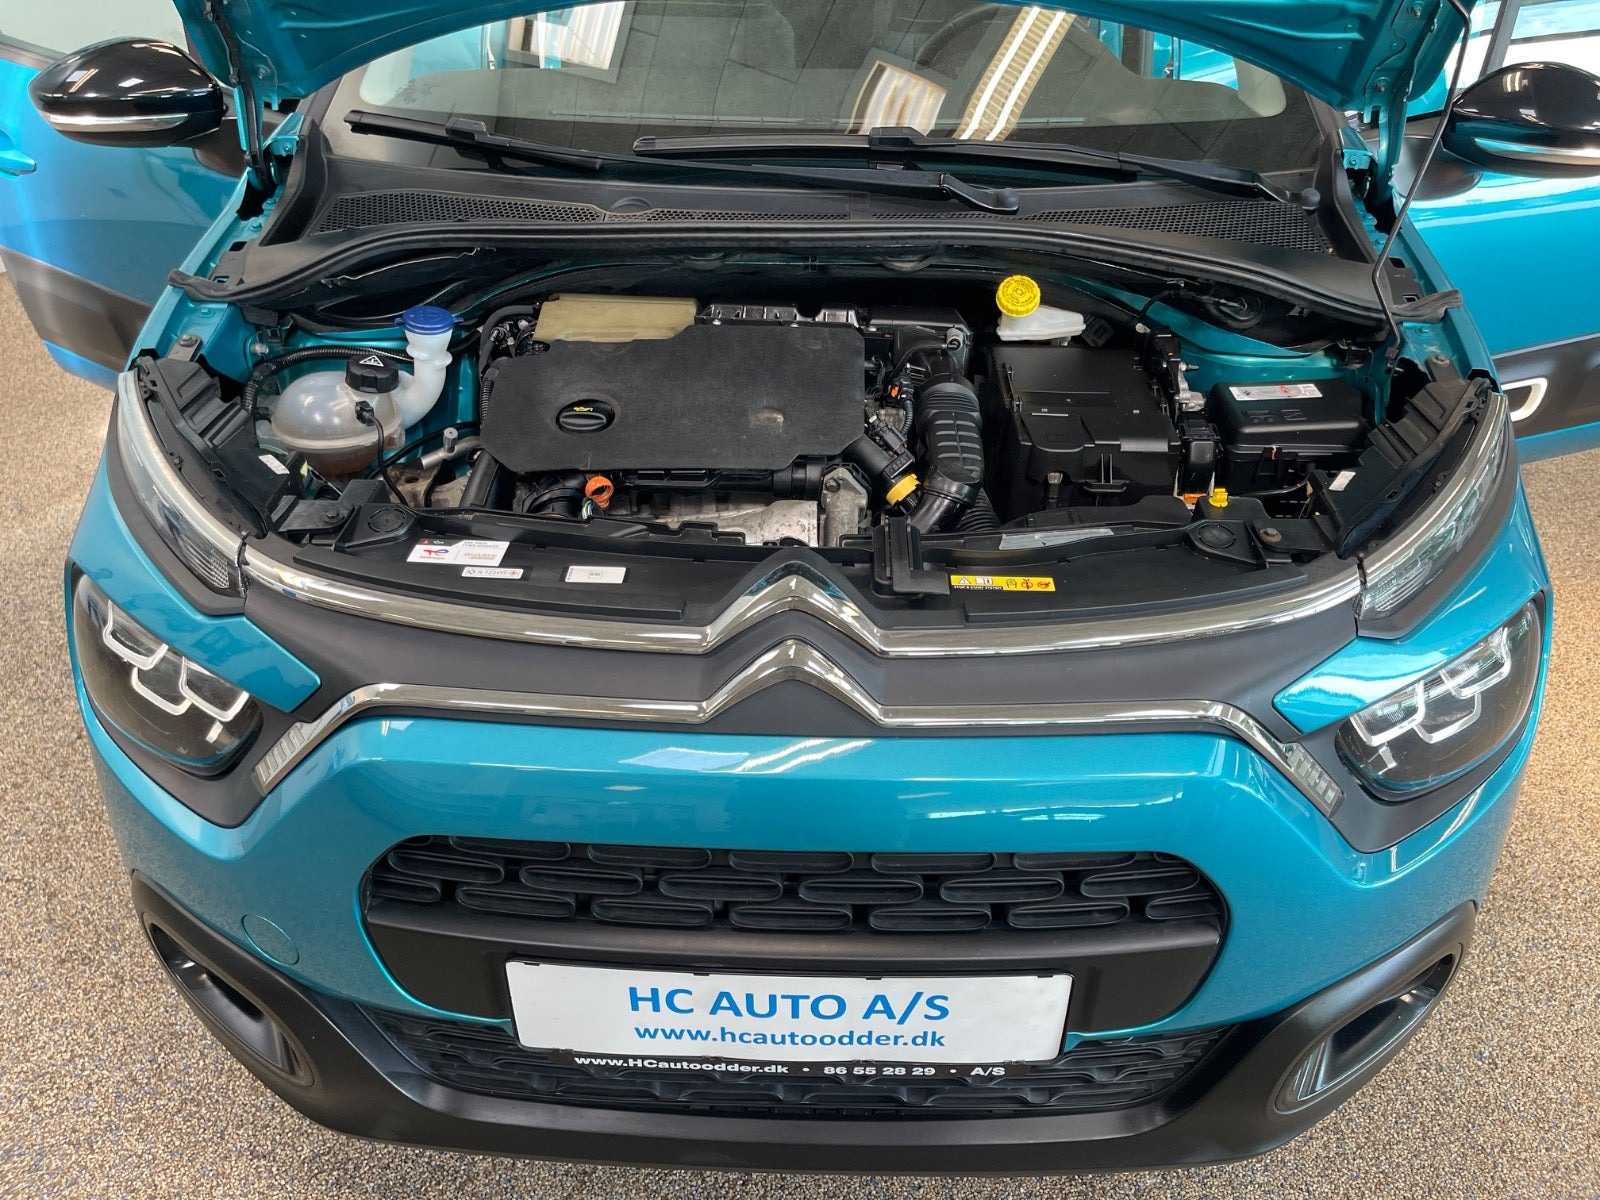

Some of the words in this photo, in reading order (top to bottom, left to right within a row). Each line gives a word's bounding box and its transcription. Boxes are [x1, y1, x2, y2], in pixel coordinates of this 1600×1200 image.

[628, 985, 695, 1015] HC
[709, 990, 848, 1021] AUTO
[862, 992, 951, 1026] A/S
[633, 1026, 946, 1048] www.hcautoodder.dk
[574, 1056, 789, 1074] www.HCautoodder.dk
[823, 1066, 848, 1075] 86
[852, 1066, 877, 1075] 55
[882, 1066, 907, 1076] 28
[911, 1067, 936, 1076] 29
[970, 1066, 1006, 1077] A/S
